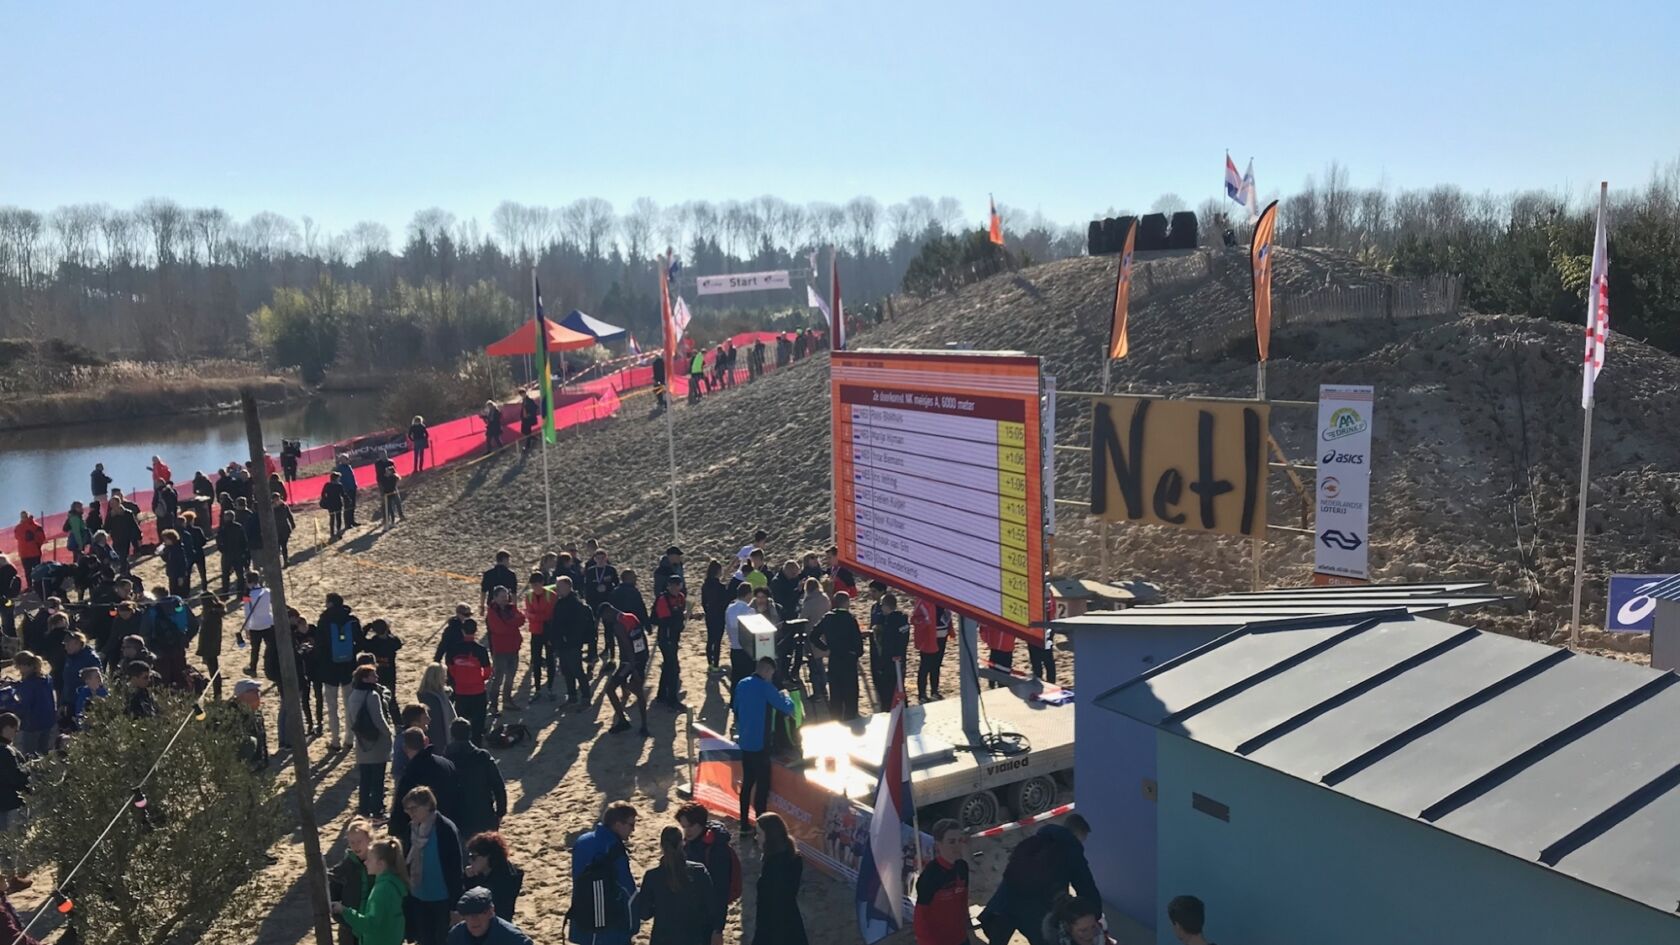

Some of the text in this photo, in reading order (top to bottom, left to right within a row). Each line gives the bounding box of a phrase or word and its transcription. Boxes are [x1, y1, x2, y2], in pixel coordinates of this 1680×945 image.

[729, 277, 758, 288] Start
[941, 396, 957, 409] 6000
[957, 399, 975, 411] meter
[1005, 426, 1024, 440] 15:05
[1335, 453, 1364, 464] asics
[1320, 500, 1363, 510] NEDERLANDSE
[1320, 506, 1347, 514] LOTERIJ
[1008, 552, 1026, 568] +2:02
[1057, 603, 1066, 617] 2
